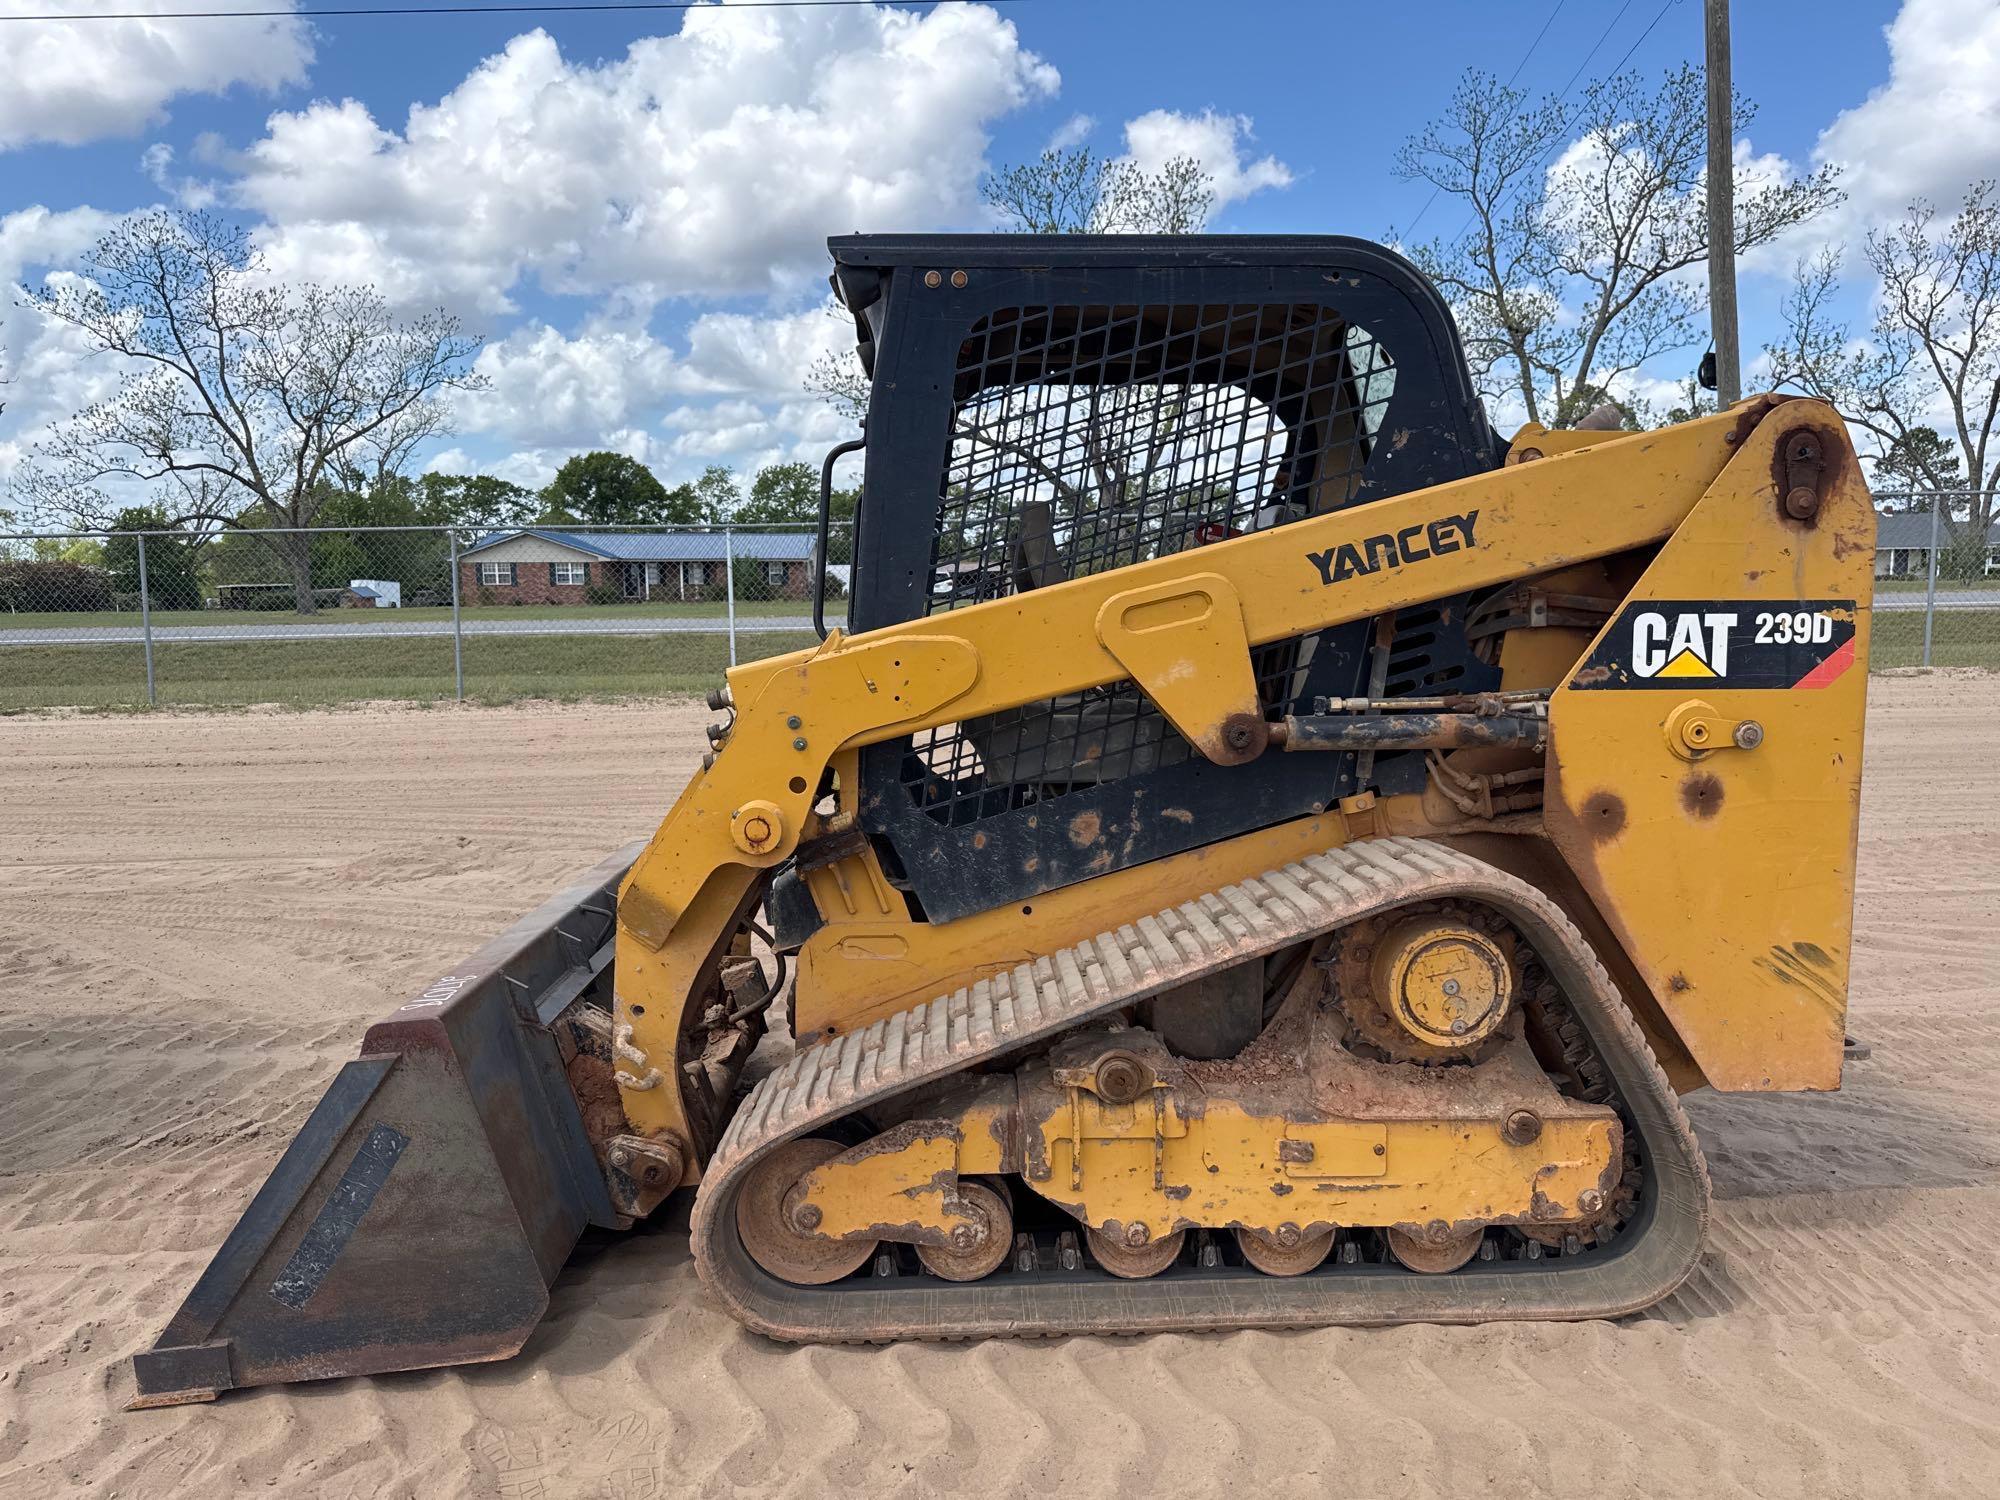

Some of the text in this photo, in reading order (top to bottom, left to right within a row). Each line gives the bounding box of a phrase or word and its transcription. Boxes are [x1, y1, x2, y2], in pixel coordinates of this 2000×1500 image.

[1305, 509, 1480, 585] YANCEY
[1632, 612, 1833, 678] CAT 239D
